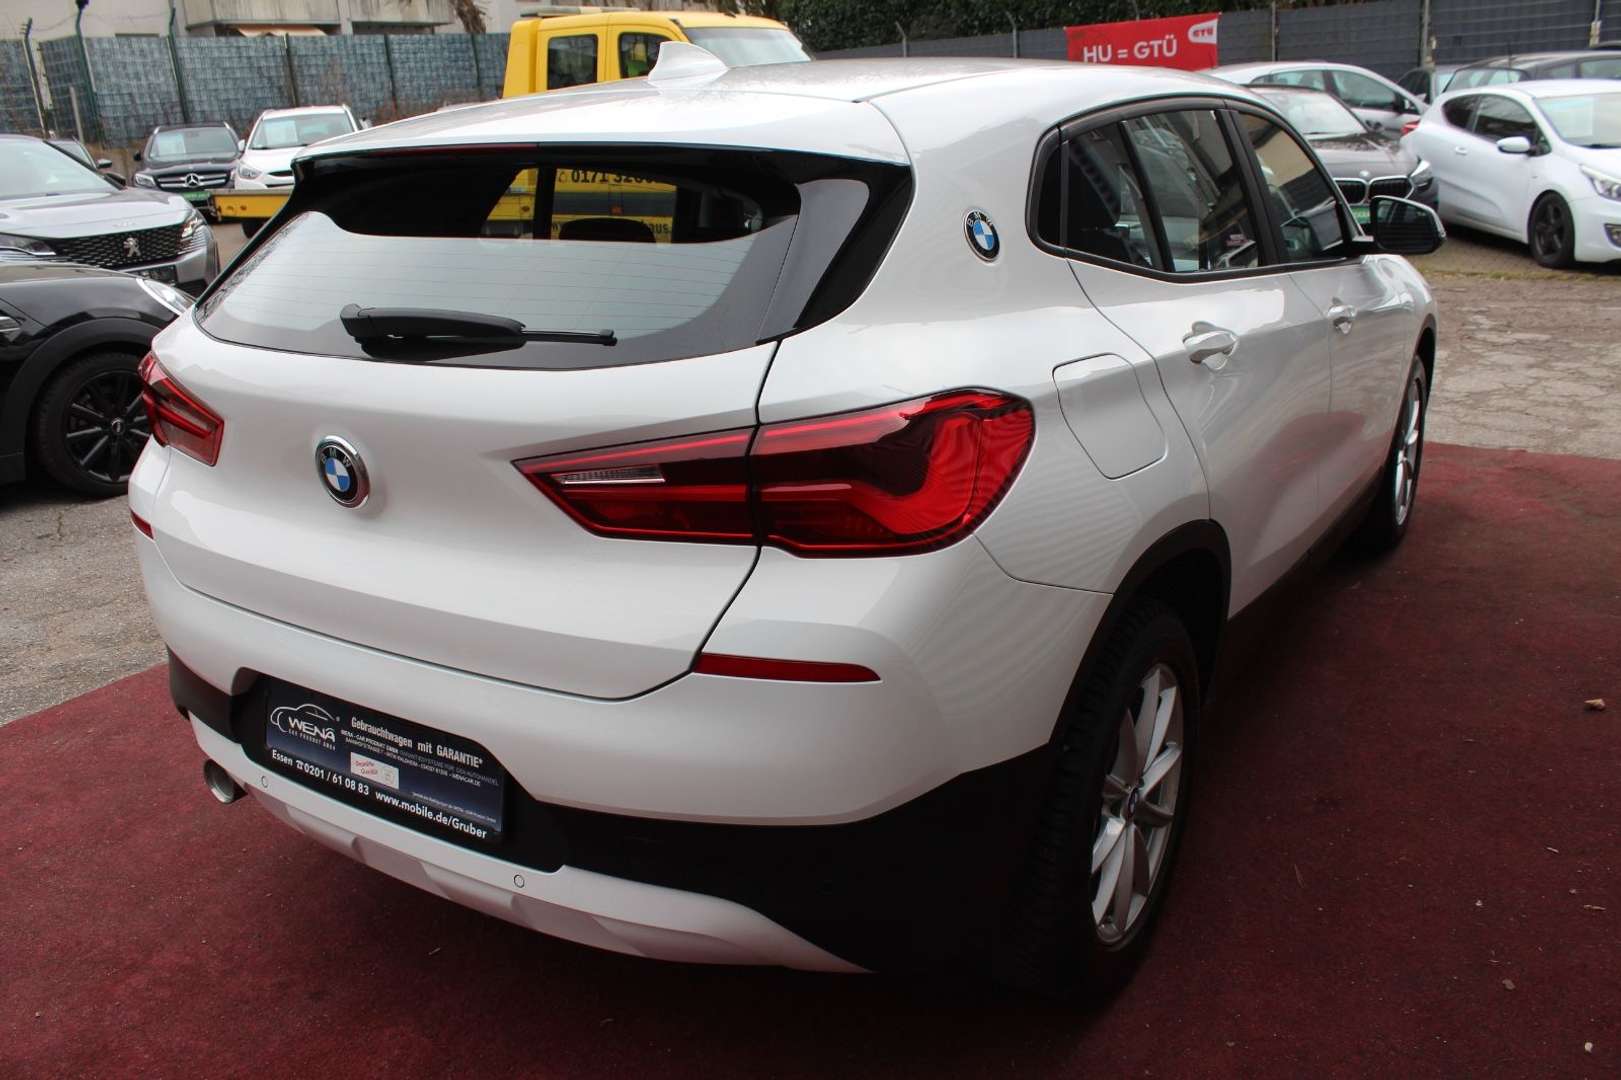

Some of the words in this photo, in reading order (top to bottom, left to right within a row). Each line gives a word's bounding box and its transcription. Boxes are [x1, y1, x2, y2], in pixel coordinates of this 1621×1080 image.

[1083, 44, 1112, 62] HU
[1134, 34, 1177, 58] GTÜ
[351, 716, 412, 749] Gebrauchtwagen
[417, 742, 433, 754] mit
[272, 749, 294, 767] Essen
[332, 773, 343, 785] 61
[345, 778, 356, 790] 08
[357, 783, 369, 795] 83
[375, 790, 488, 839] www.mobile.de/Gruber
